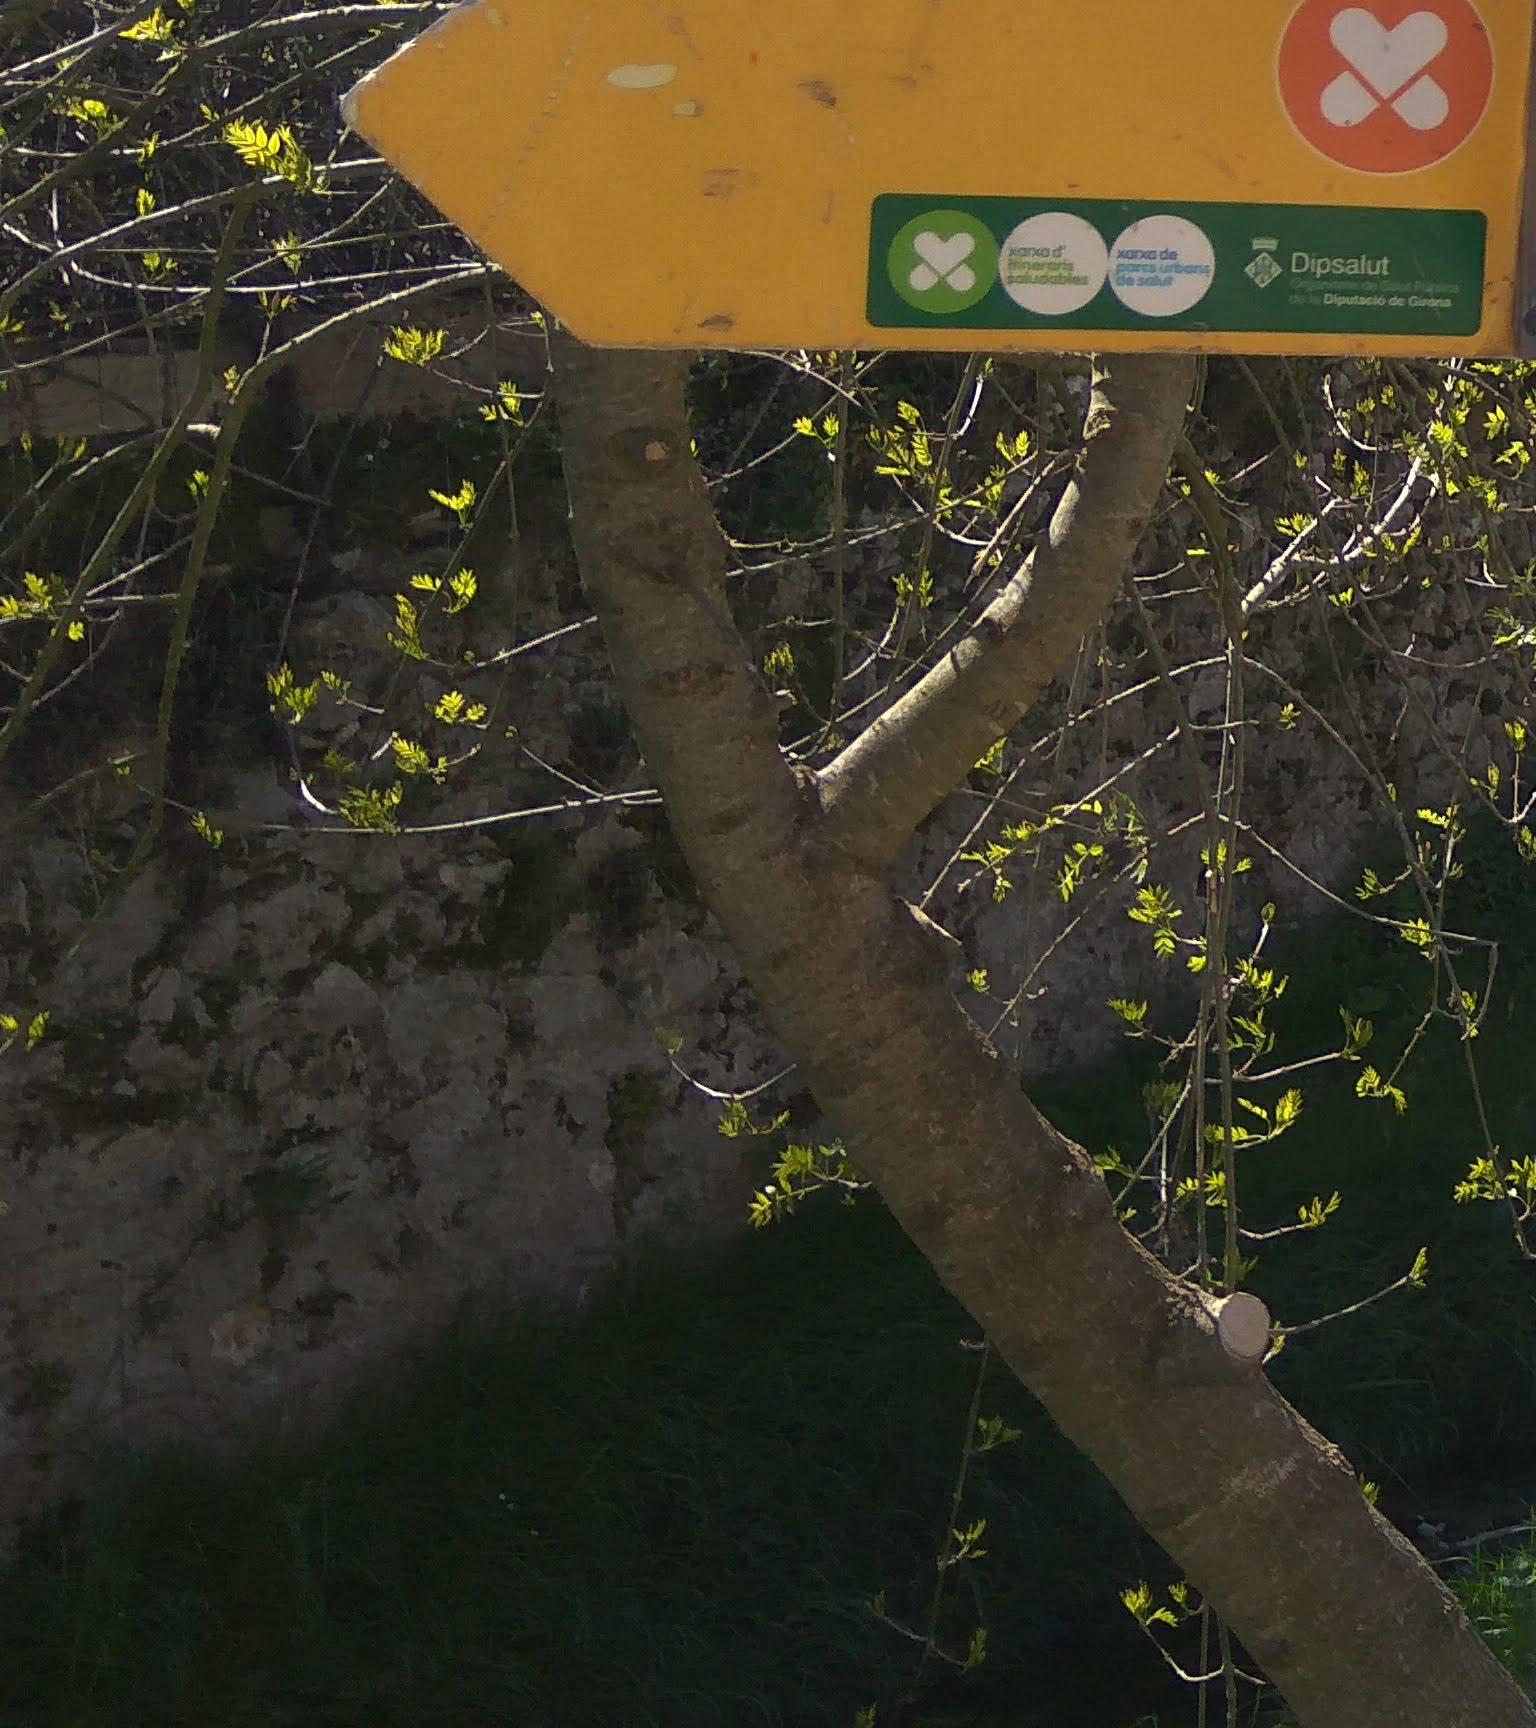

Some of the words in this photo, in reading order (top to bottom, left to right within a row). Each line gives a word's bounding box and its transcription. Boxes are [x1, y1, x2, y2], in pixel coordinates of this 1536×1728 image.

[1116, 248, 1157, 260] xarxa
[1159, 247, 1178, 261] de
[1291, 251, 1390, 278] Dipsalut
[1388, 295, 1405, 306] de
